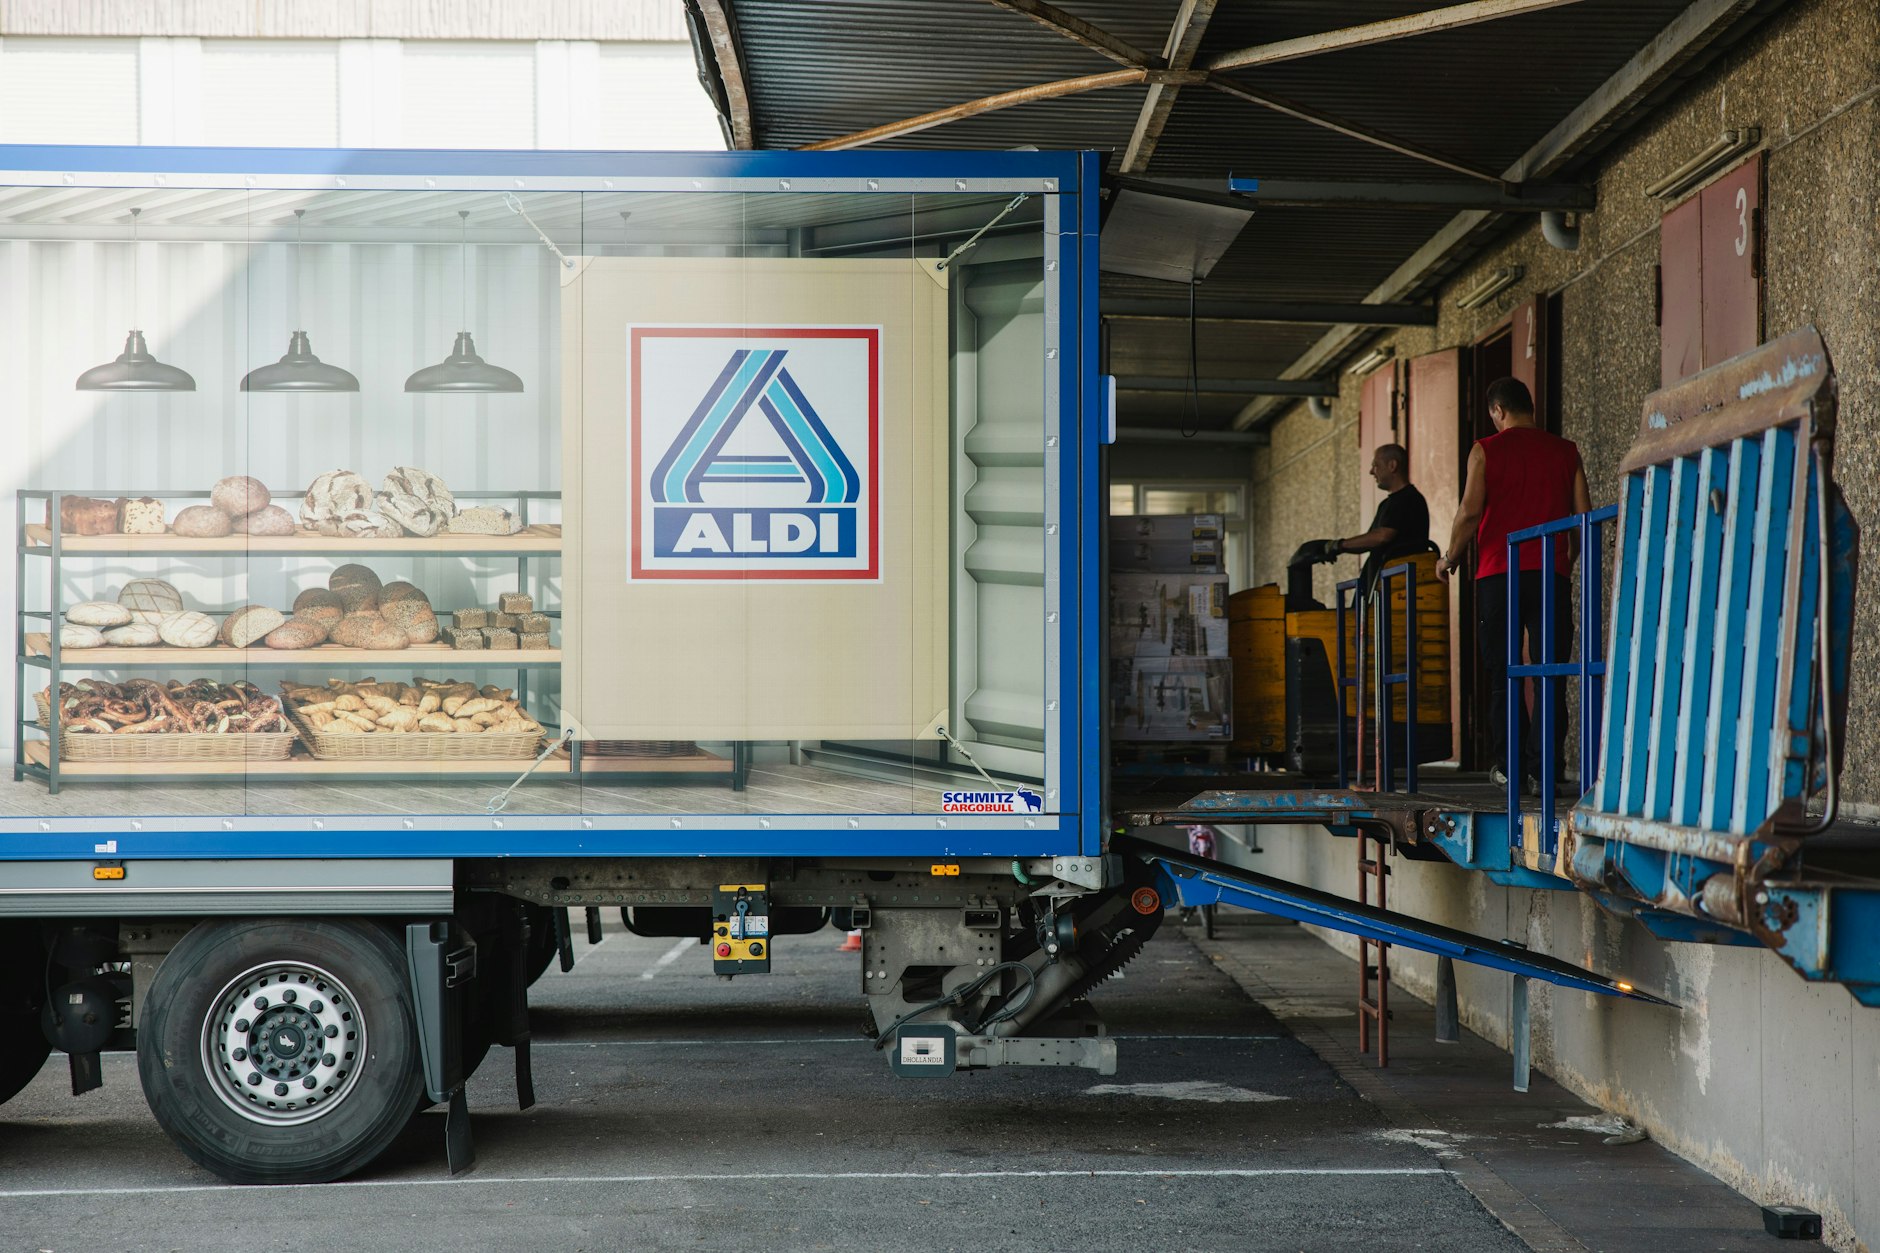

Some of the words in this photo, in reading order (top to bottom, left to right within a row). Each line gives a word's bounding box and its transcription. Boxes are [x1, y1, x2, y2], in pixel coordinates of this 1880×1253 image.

[1735, 187, 1747, 257] 3
[1526, 305, 1533, 359] 2
[672, 512, 839, 553] ALDI
[943, 793, 1014, 803] SCHMITZ
[943, 804, 1014, 812] CARGOBULL
